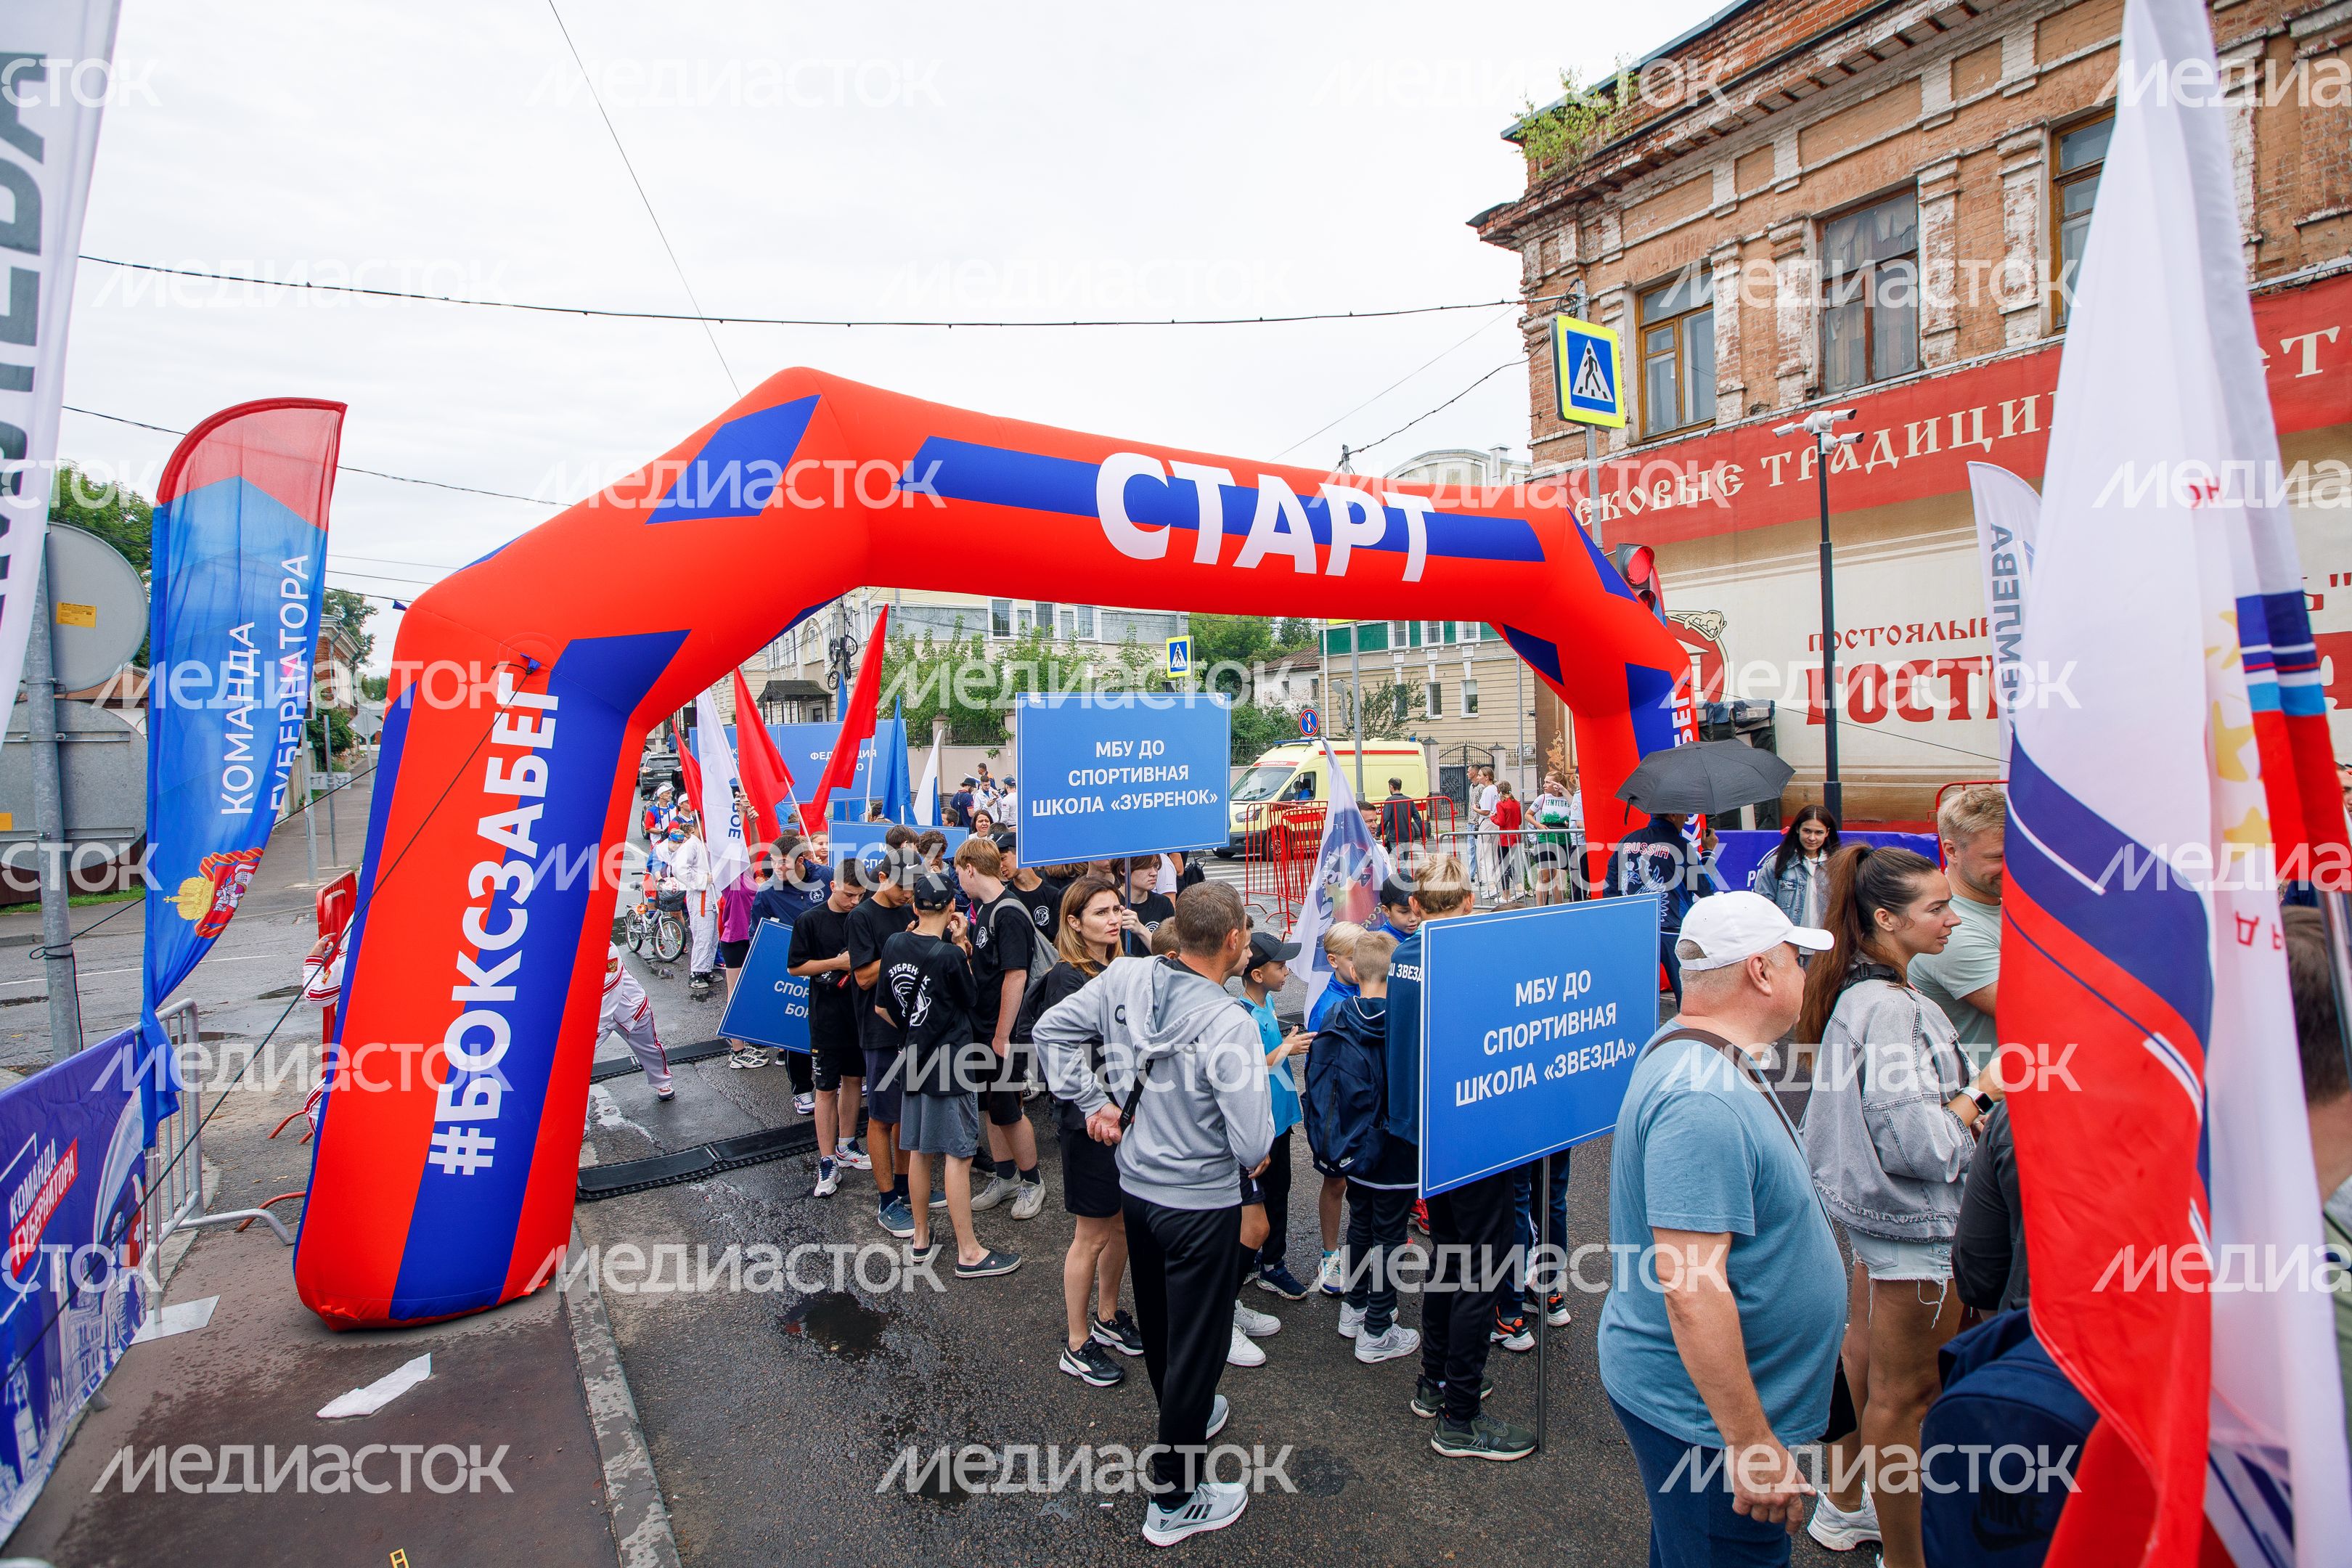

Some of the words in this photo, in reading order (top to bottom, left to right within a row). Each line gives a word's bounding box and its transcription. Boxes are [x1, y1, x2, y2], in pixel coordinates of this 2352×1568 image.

[1574, 464, 1744, 526] ЕКОВЫЕ
[1760, 391, 2057, 487] ТРАДИЦИ
[1095, 452, 1435, 582] СТАРТ
[221, 621, 261, 814] КОМАНДА
[1067, 764, 1189, 787] СПОРТИВНАЯ
[1095, 740, 1135, 759] МБУ
[1139, 740, 1165, 759] ДО
[1032, 797, 1105, 817] ШКОЛА
[1110, 789, 1219, 813] «ЗУБРЕНОК»
[1622, 842, 1670, 859] RUSSIA
[428, 671, 559, 1176] #БОКСЗАБЕГ
[888, 963, 931, 986] ЗУБРЕНК
[1515, 976, 1559, 1007] МБУ
[1563, 969, 1591, 1002] ДО
[1483, 1003, 1617, 1055] СПОРТИВНАЯ
[1455, 1062, 1538, 1107] ШКОЛА
[1544, 1038, 1637, 1081] «ЗВЕЗДА»
[9, 1138, 57, 1230] КОМАНДА
[15, 1149, 75, 1266] ГУБЕРНАТОРА
